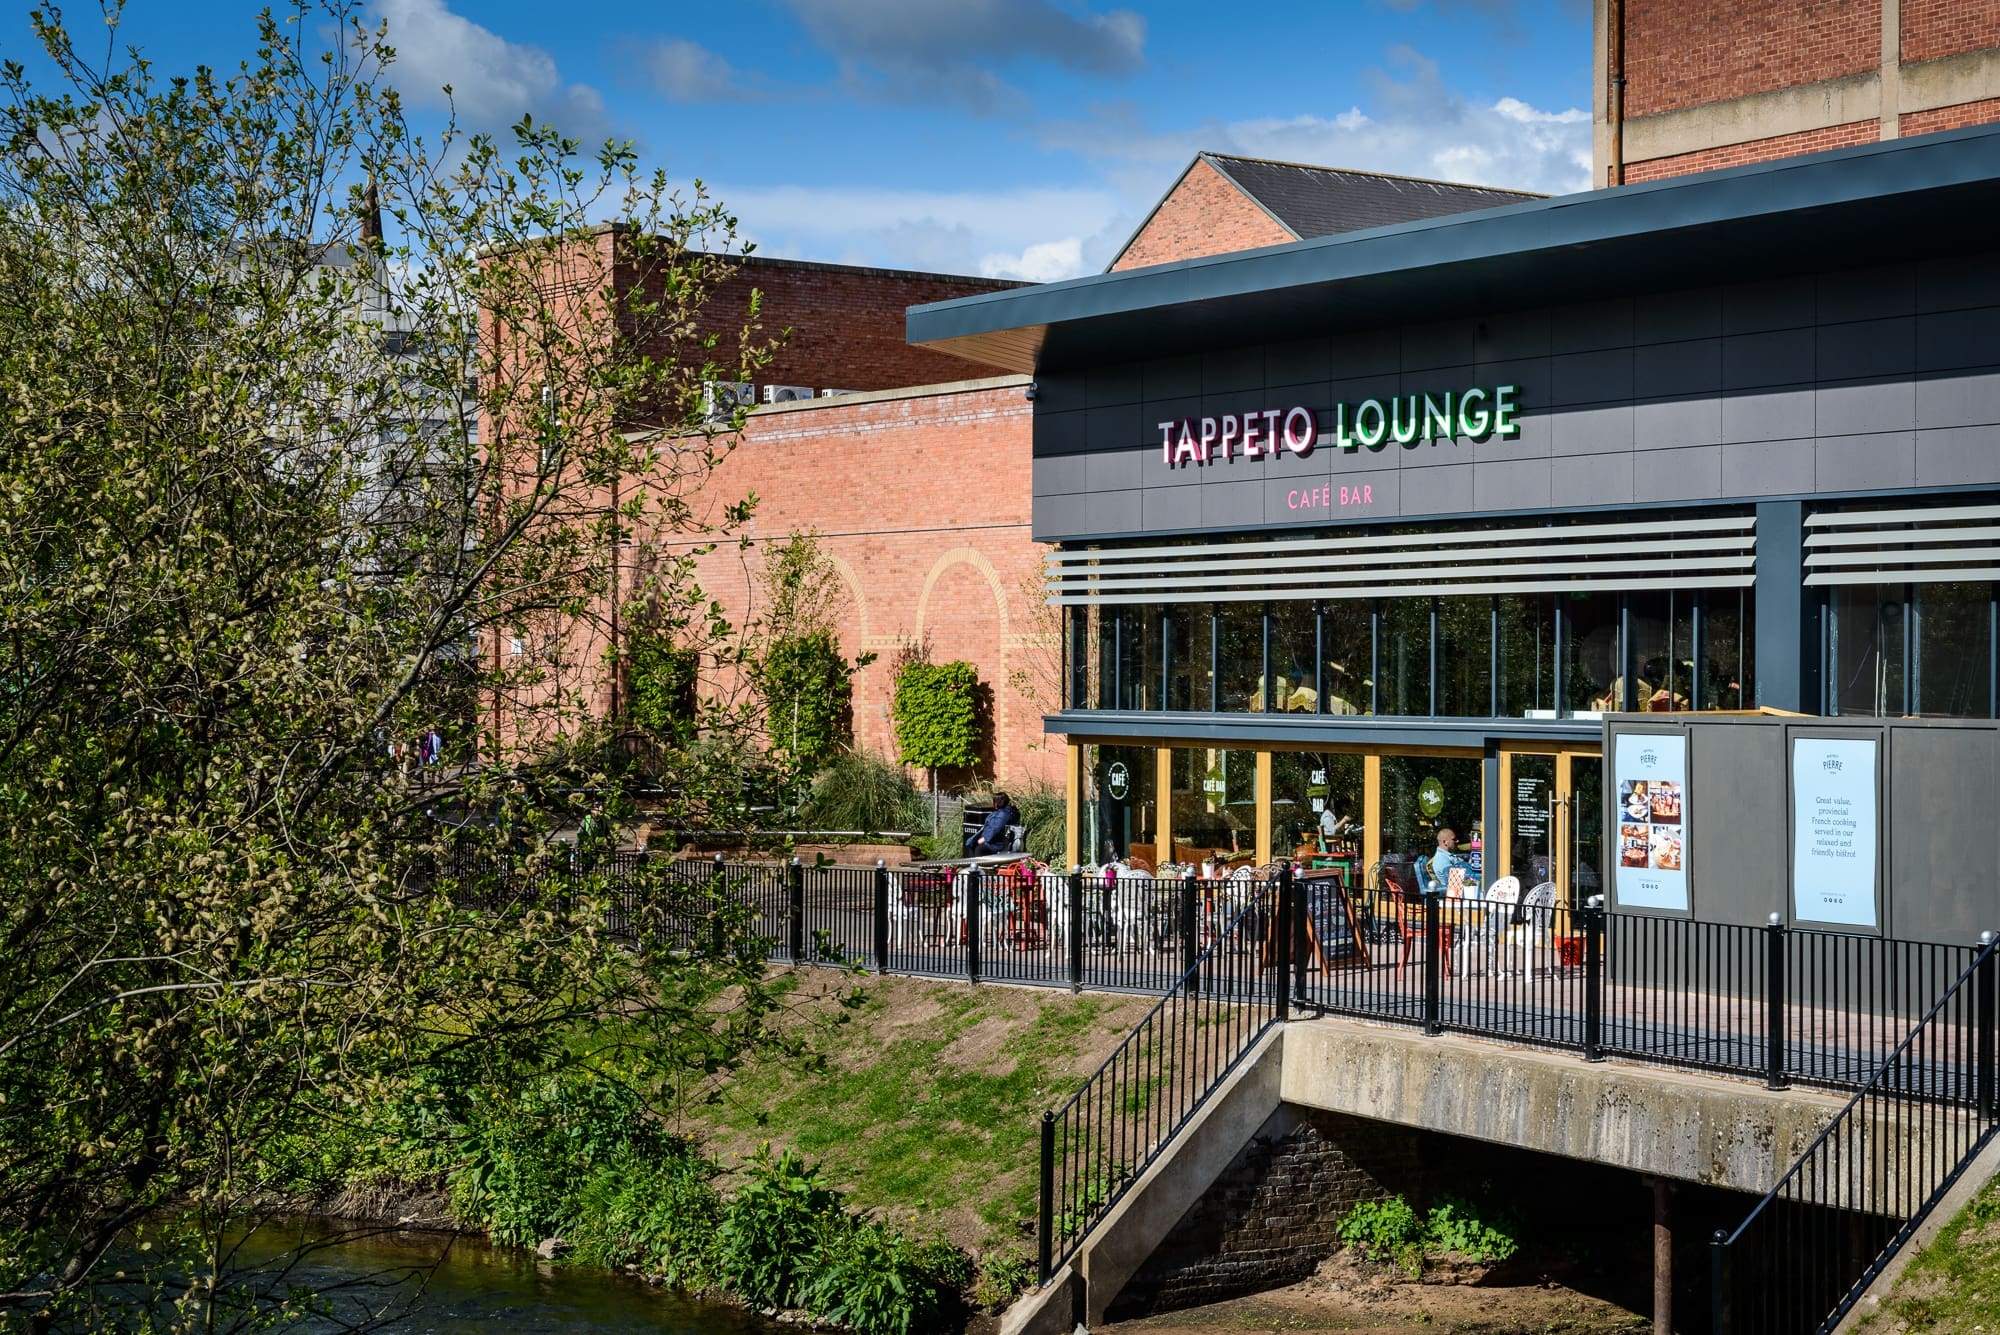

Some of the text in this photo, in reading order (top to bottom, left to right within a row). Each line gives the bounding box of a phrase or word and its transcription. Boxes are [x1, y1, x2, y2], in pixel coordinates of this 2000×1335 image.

[1158, 385, 1519, 464] TAPPETO LOUNGE
[1287, 482, 1373, 510] CAFÉ BAR
[1823, 759, 1843, 771] PIERRE
[1111, 770, 1125, 787] CAFÉ
[1311, 768, 1326, 785] CAFÉ
[1815, 796, 1832, 804] Great
[1818, 807, 1849, 816] provincial
[1811, 816, 1857, 828] French cooking
[1816, 838, 1839, 846] relaxed
[1811, 847, 1835, 858] friendly
